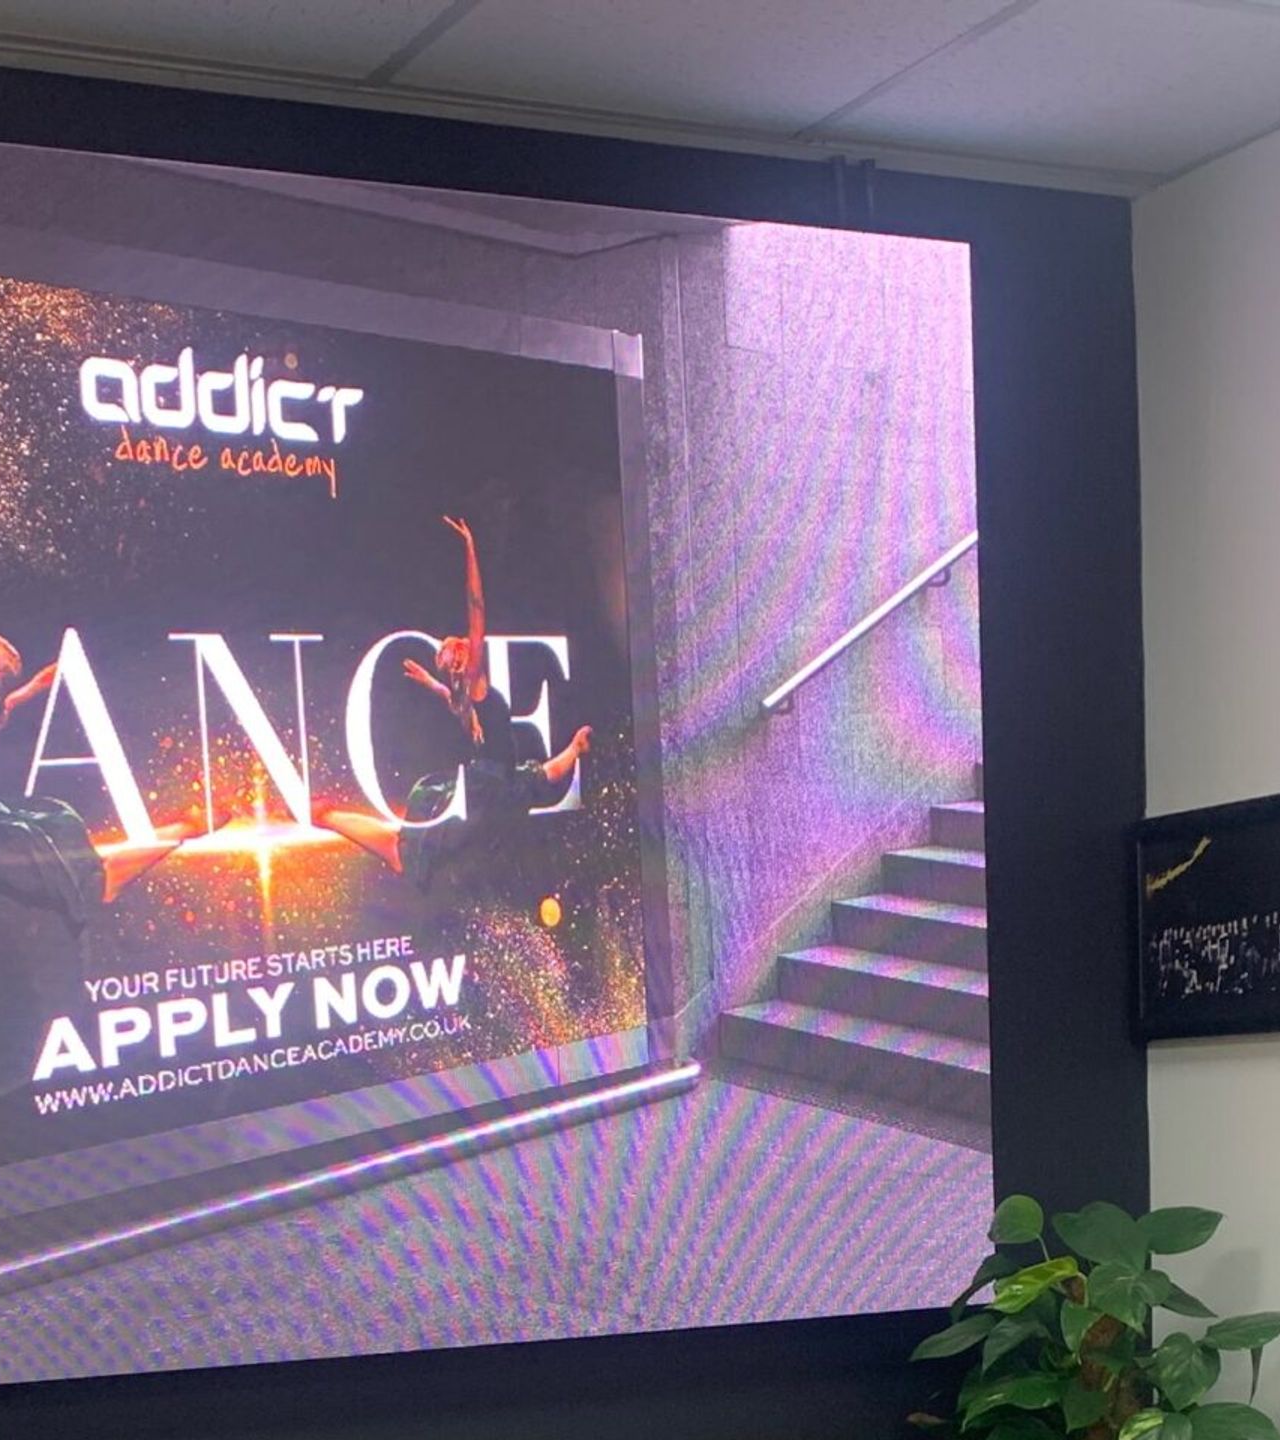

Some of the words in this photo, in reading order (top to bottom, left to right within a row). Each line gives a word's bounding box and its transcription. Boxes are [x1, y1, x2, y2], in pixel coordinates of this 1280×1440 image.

[114, 424, 209, 472] dance
[220, 437, 338, 499] academy
[84, 971, 160, 1003] YOUR
[164, 956, 265, 991] FUTURE
[266, 943, 354, 977] STARTS
[356, 935, 415, 963] HERE
[31, 982, 295, 1082] APPLY
[313, 953, 467, 1030] NOW
[34, 1014, 472, 1115] WWW.ADDICTDANCEACADEMY.CO.UK
